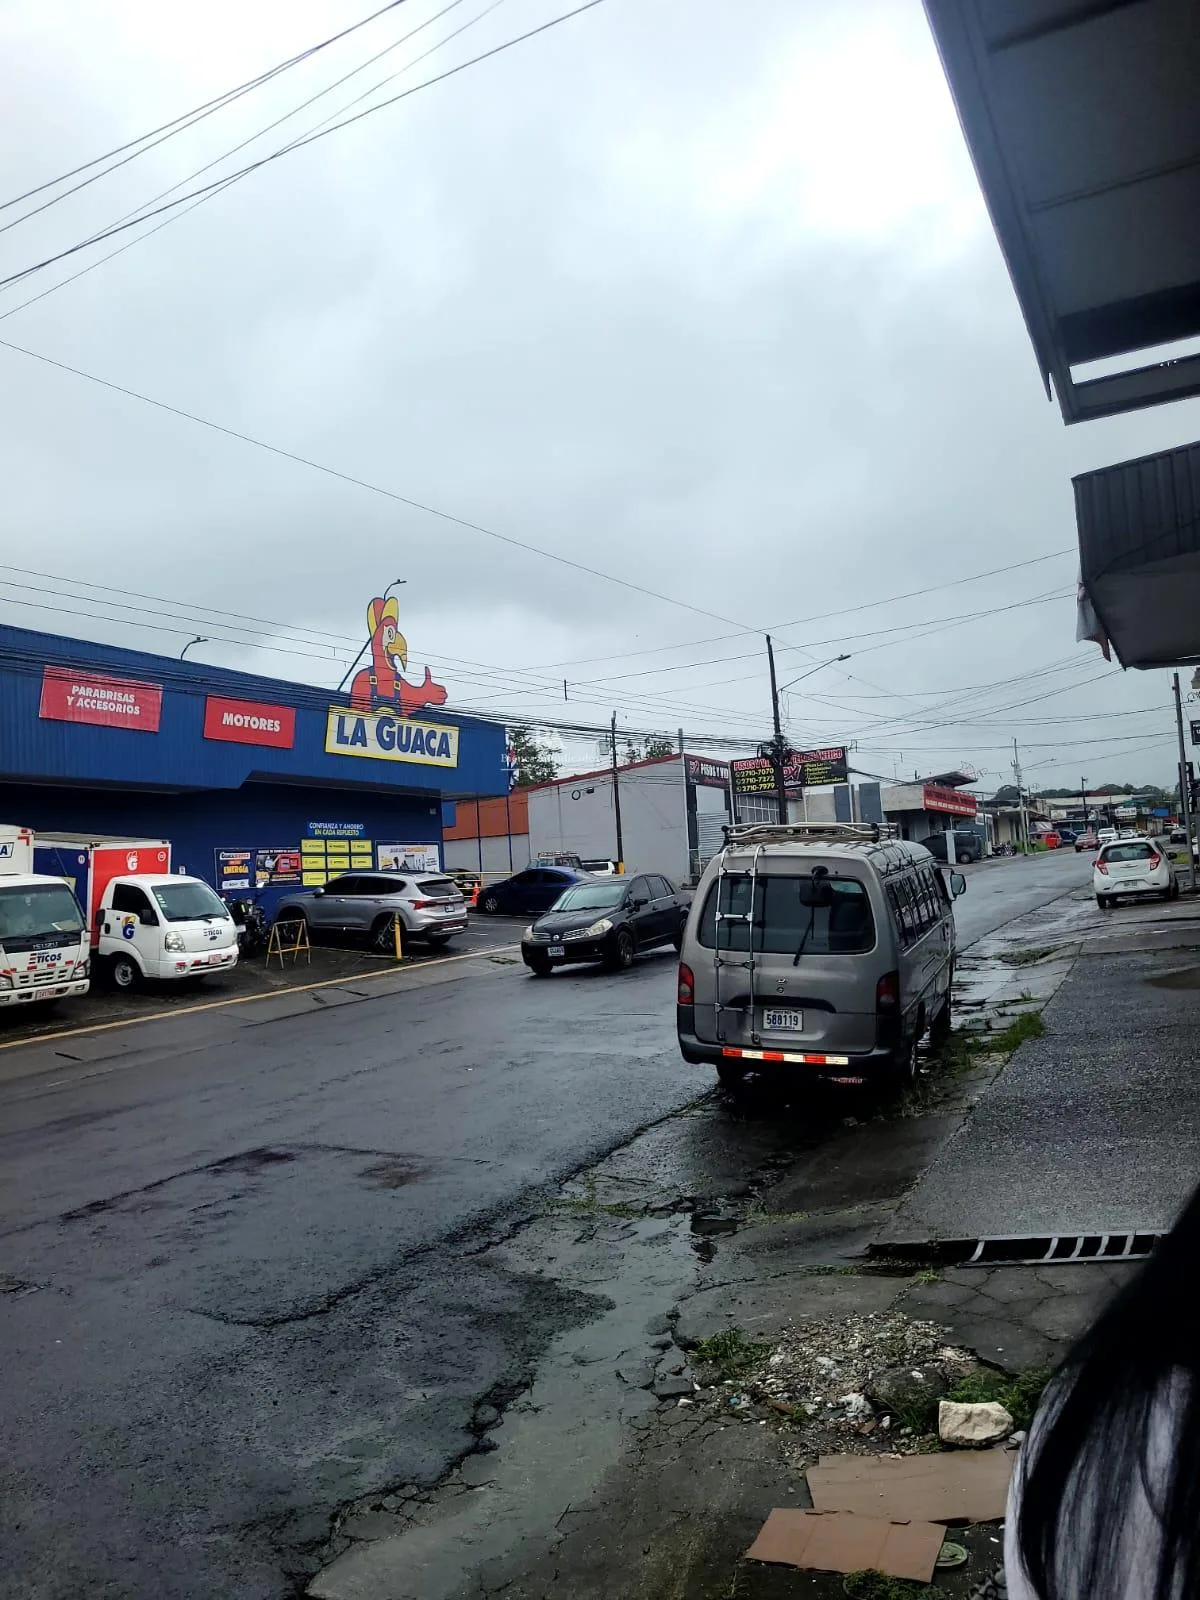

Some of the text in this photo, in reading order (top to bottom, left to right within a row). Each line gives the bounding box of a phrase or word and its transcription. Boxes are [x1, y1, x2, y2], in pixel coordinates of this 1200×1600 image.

[72, 685, 135, 703] PARABRISAS
[66, 695, 140, 715] Y ACCESORIOS
[221, 712, 281, 733] MOTORES
[336, 714, 451, 759] LA GUACA
[733, 759, 755, 772] PISOS
[740, 767, 774, 777] 2710-7070
[309, 822, 338, 830] CONFIANZA
[122, 924, 135, 940] G
[32, 941, 59, 950] ISUZU
[37, 953, 62, 964] TICOS
